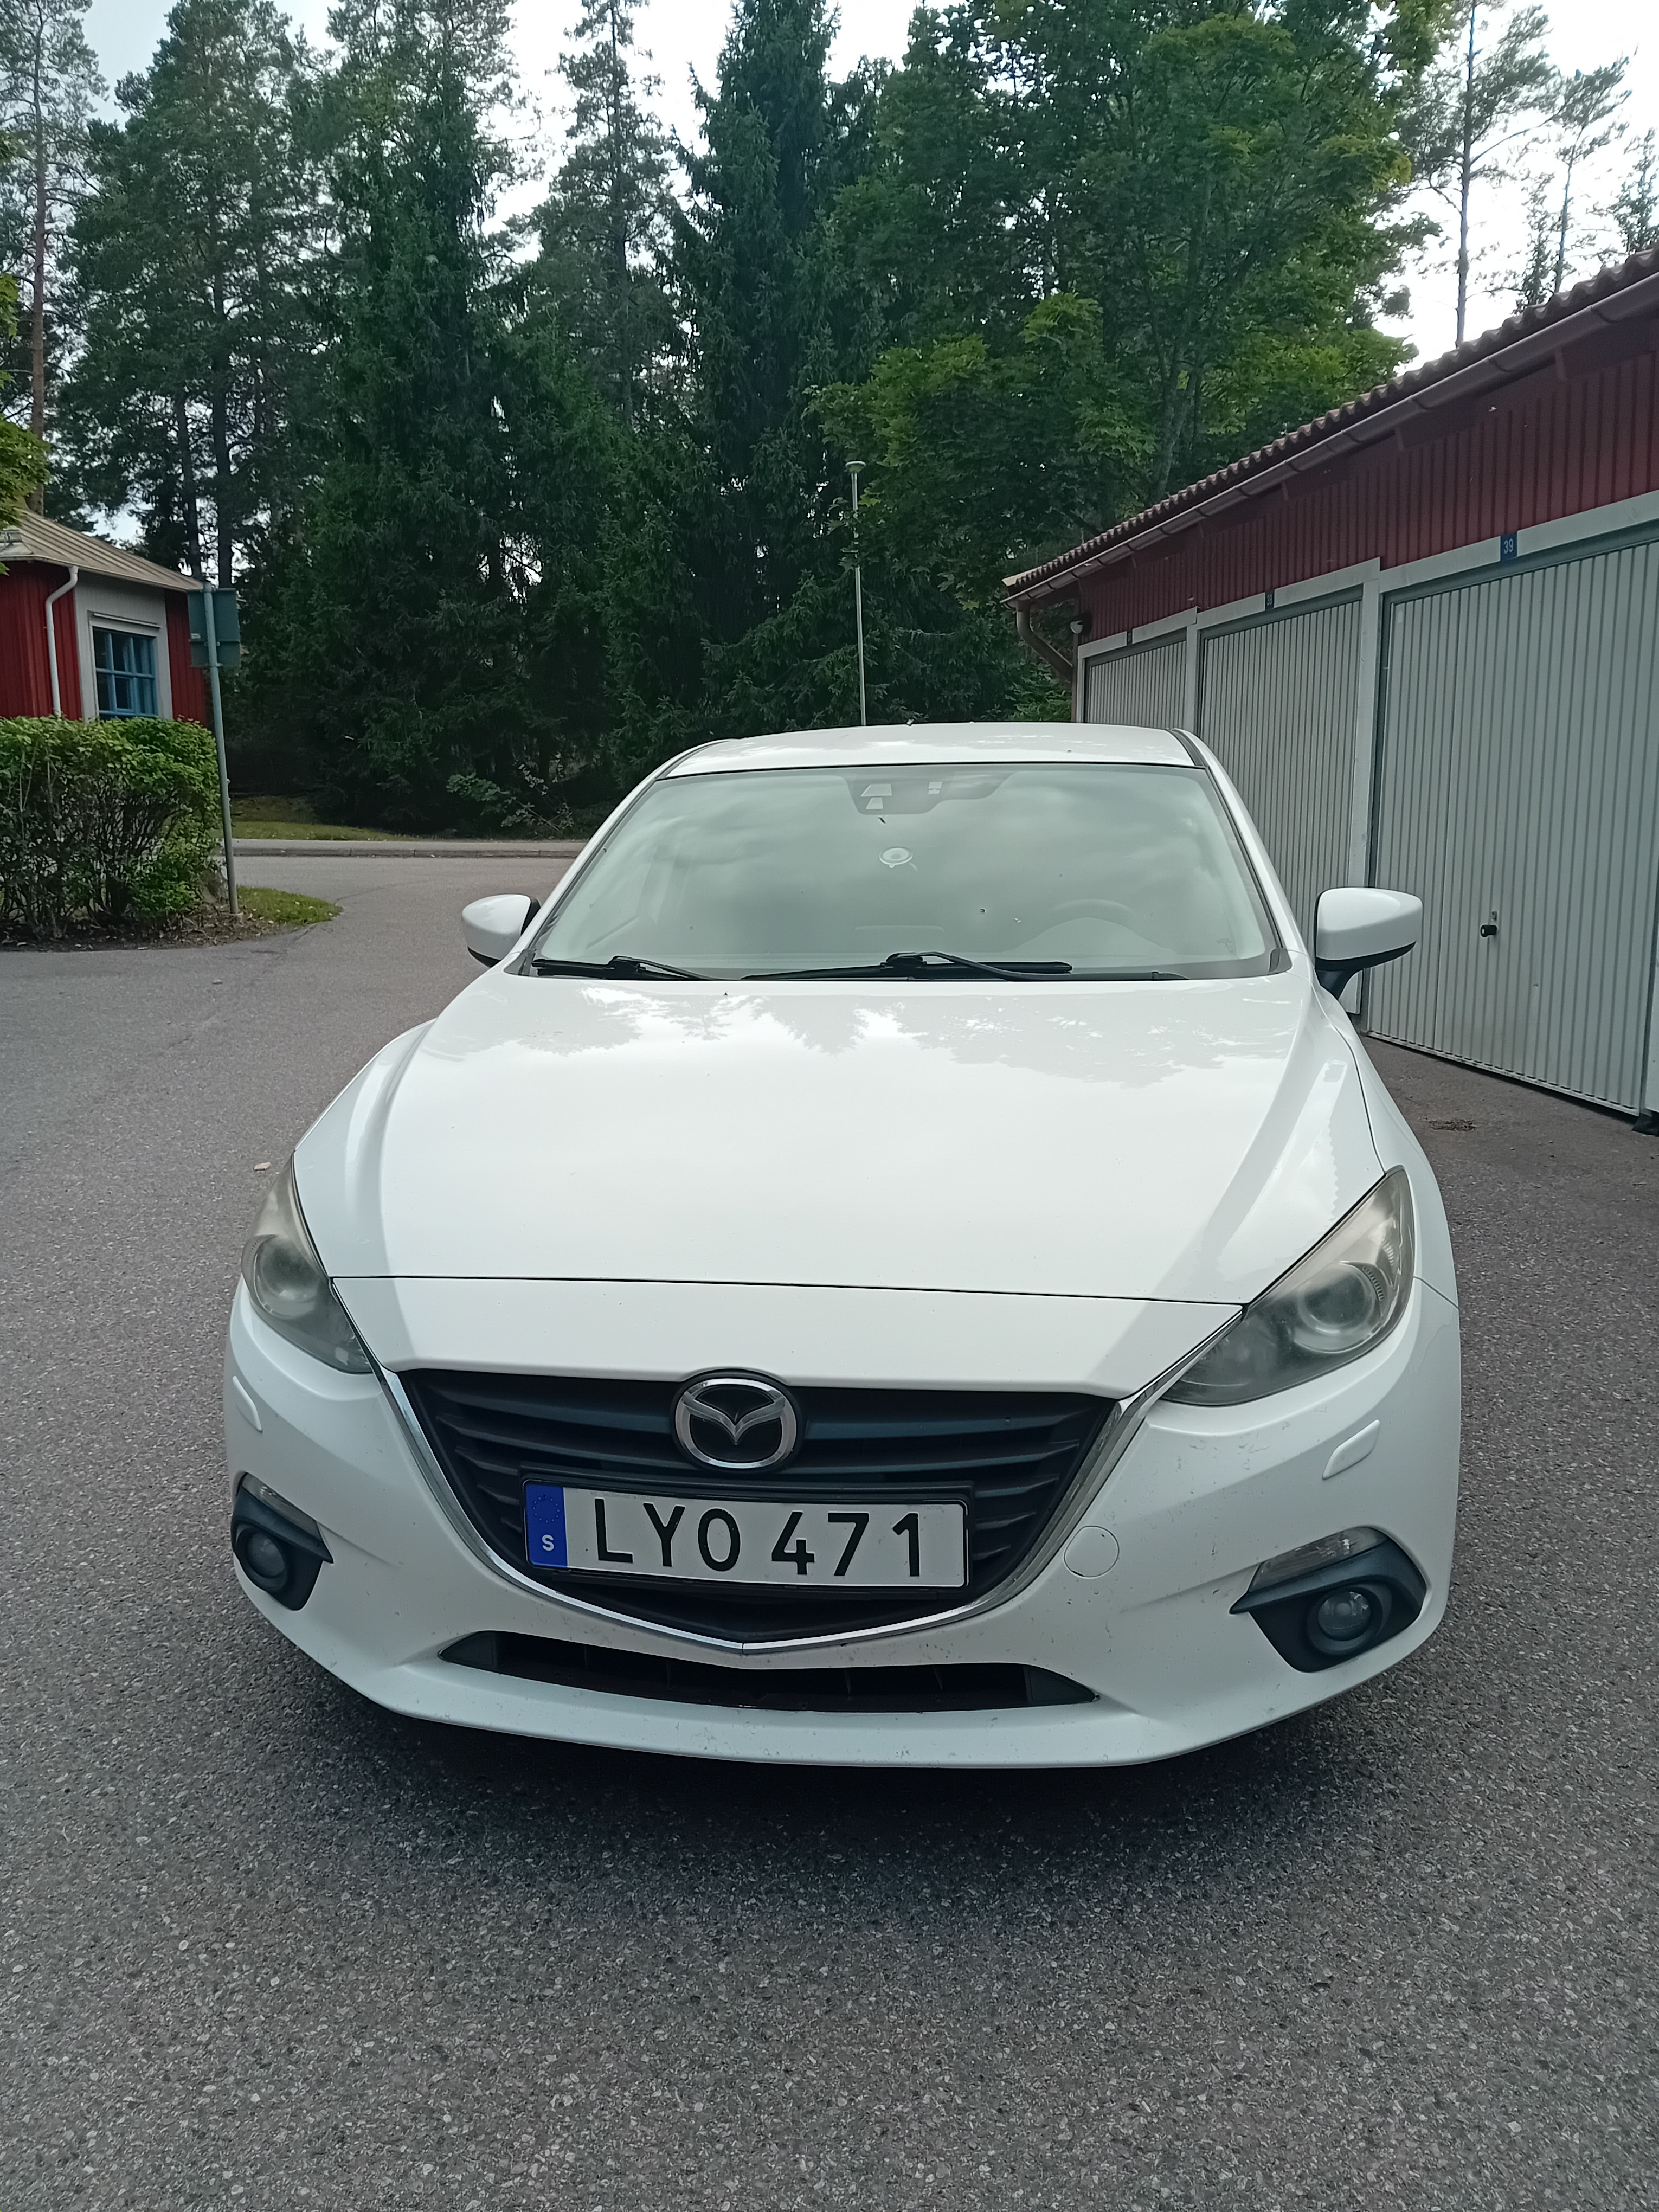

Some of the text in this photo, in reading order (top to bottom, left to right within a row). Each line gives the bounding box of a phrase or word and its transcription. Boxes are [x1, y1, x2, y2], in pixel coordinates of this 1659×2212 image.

[1503, 538, 1514, 554] 39
[542, 1534, 554, 1551] S
[594, 1498, 920, 1577] LYO 471
